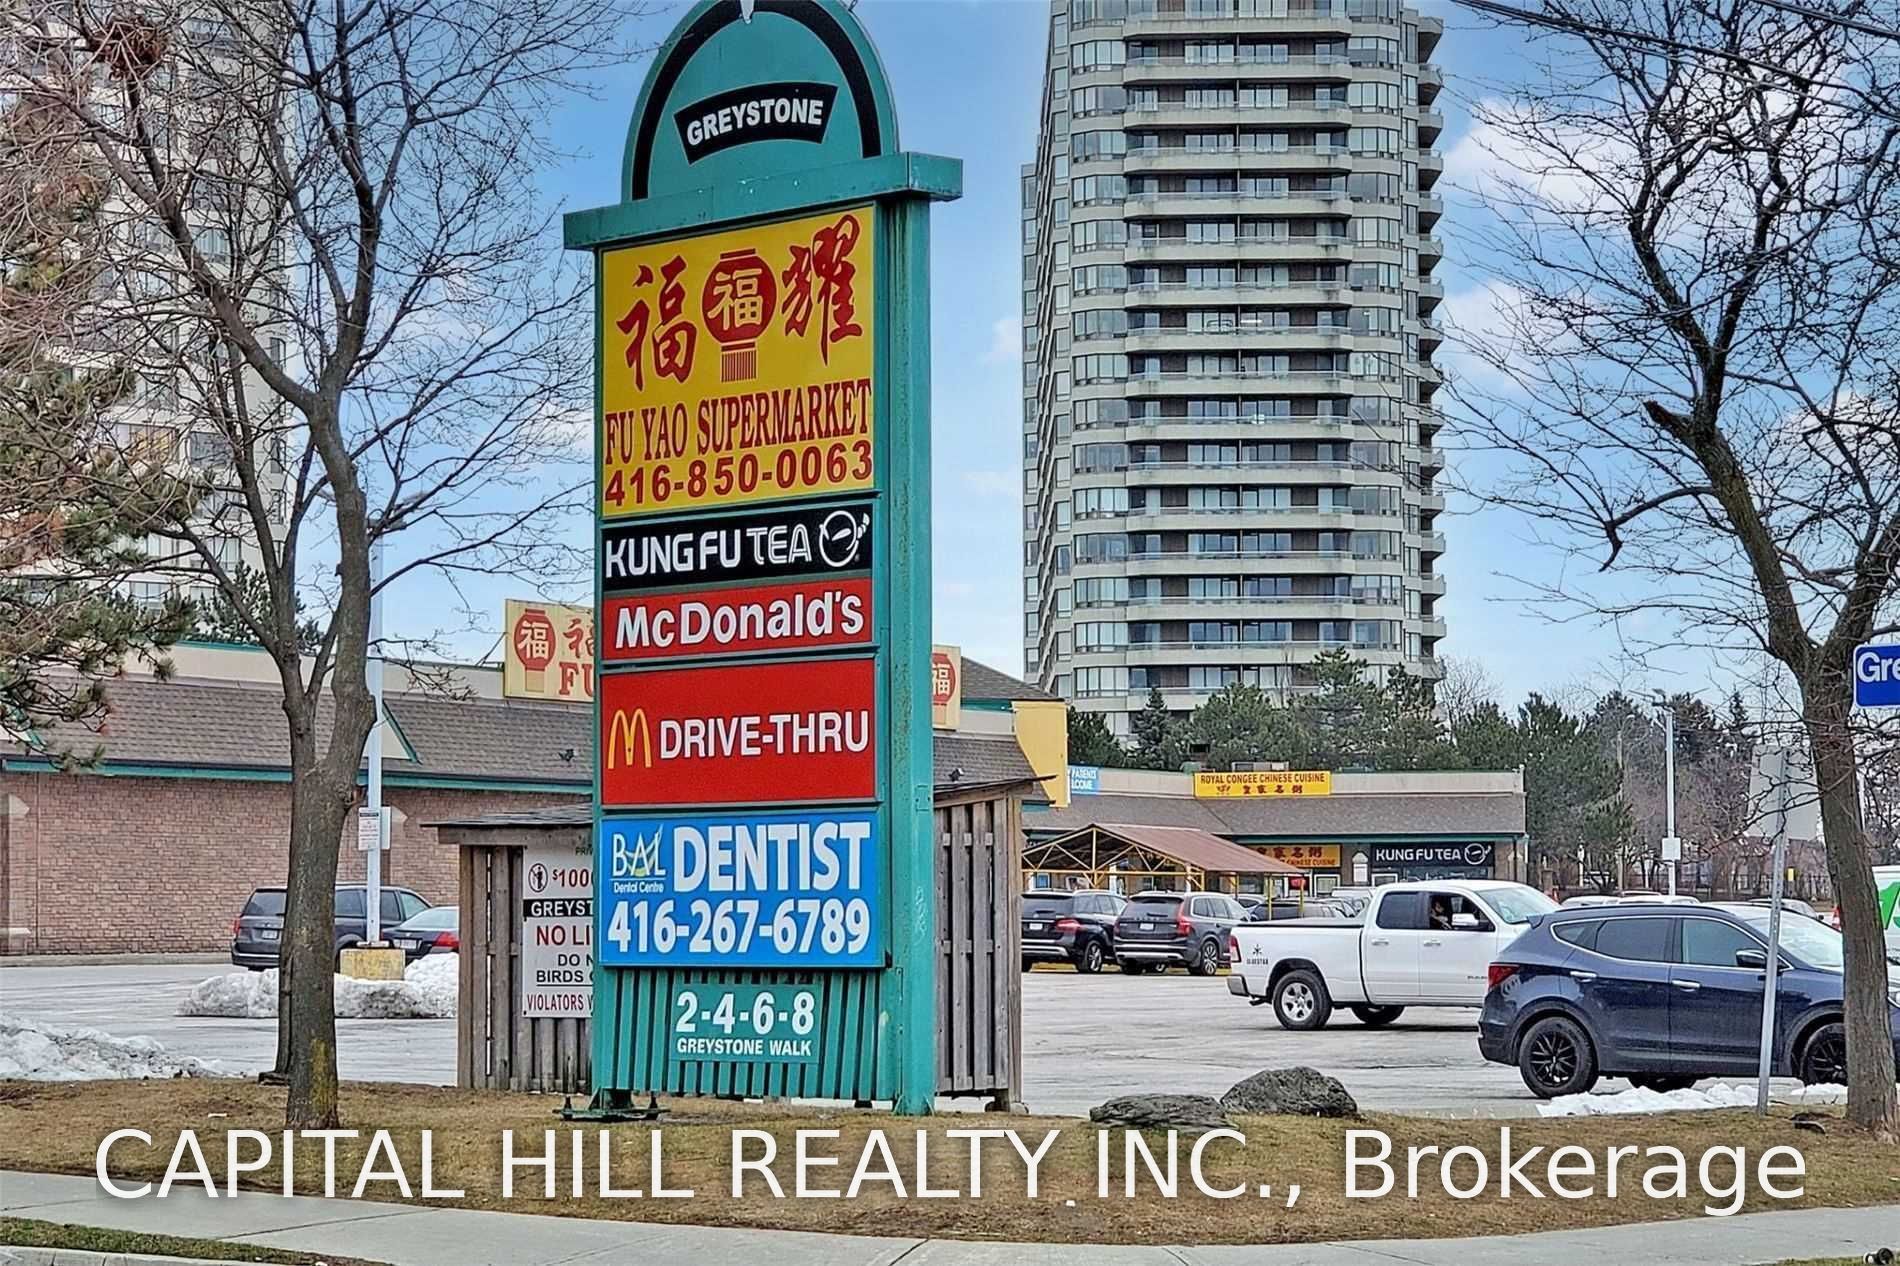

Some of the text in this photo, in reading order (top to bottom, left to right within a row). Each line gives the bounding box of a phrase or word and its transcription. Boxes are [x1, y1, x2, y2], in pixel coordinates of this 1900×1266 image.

[686, 97, 824, 146] GREYSTONE
[605, 378, 872, 465] FU YAO SUPERMARKET
[605, 440, 873, 506] 416-850-0063
[605, 523, 812, 578] KUNG FU TEA
[615, 590, 864, 649] McDonald's
[660, 711, 869, 759] DRIVE-THRU
[1200, 773, 1325, 784] ROYAL CONGEE CHINESE CUISINE
[613, 832, 666, 876] BAL
[673, 822, 870, 892] DENTIST
[1376, 849, 1461, 861] KUNG FU TEA
[552, 868, 593, 888] $100
[613, 881, 664, 893] Dental Centre
[536, 925, 566, 946] NO
[607, 898, 871, 954] 416-267-6789
[536, 970, 584, 983] BIRDS
[558, 954, 581, 967] DO
[527, 994, 584, 1011] VIOLATORS
[676, 991, 815, 1035] 2-4-6-8
[677, 1038, 811, 1056] GREYSTONE WALK
